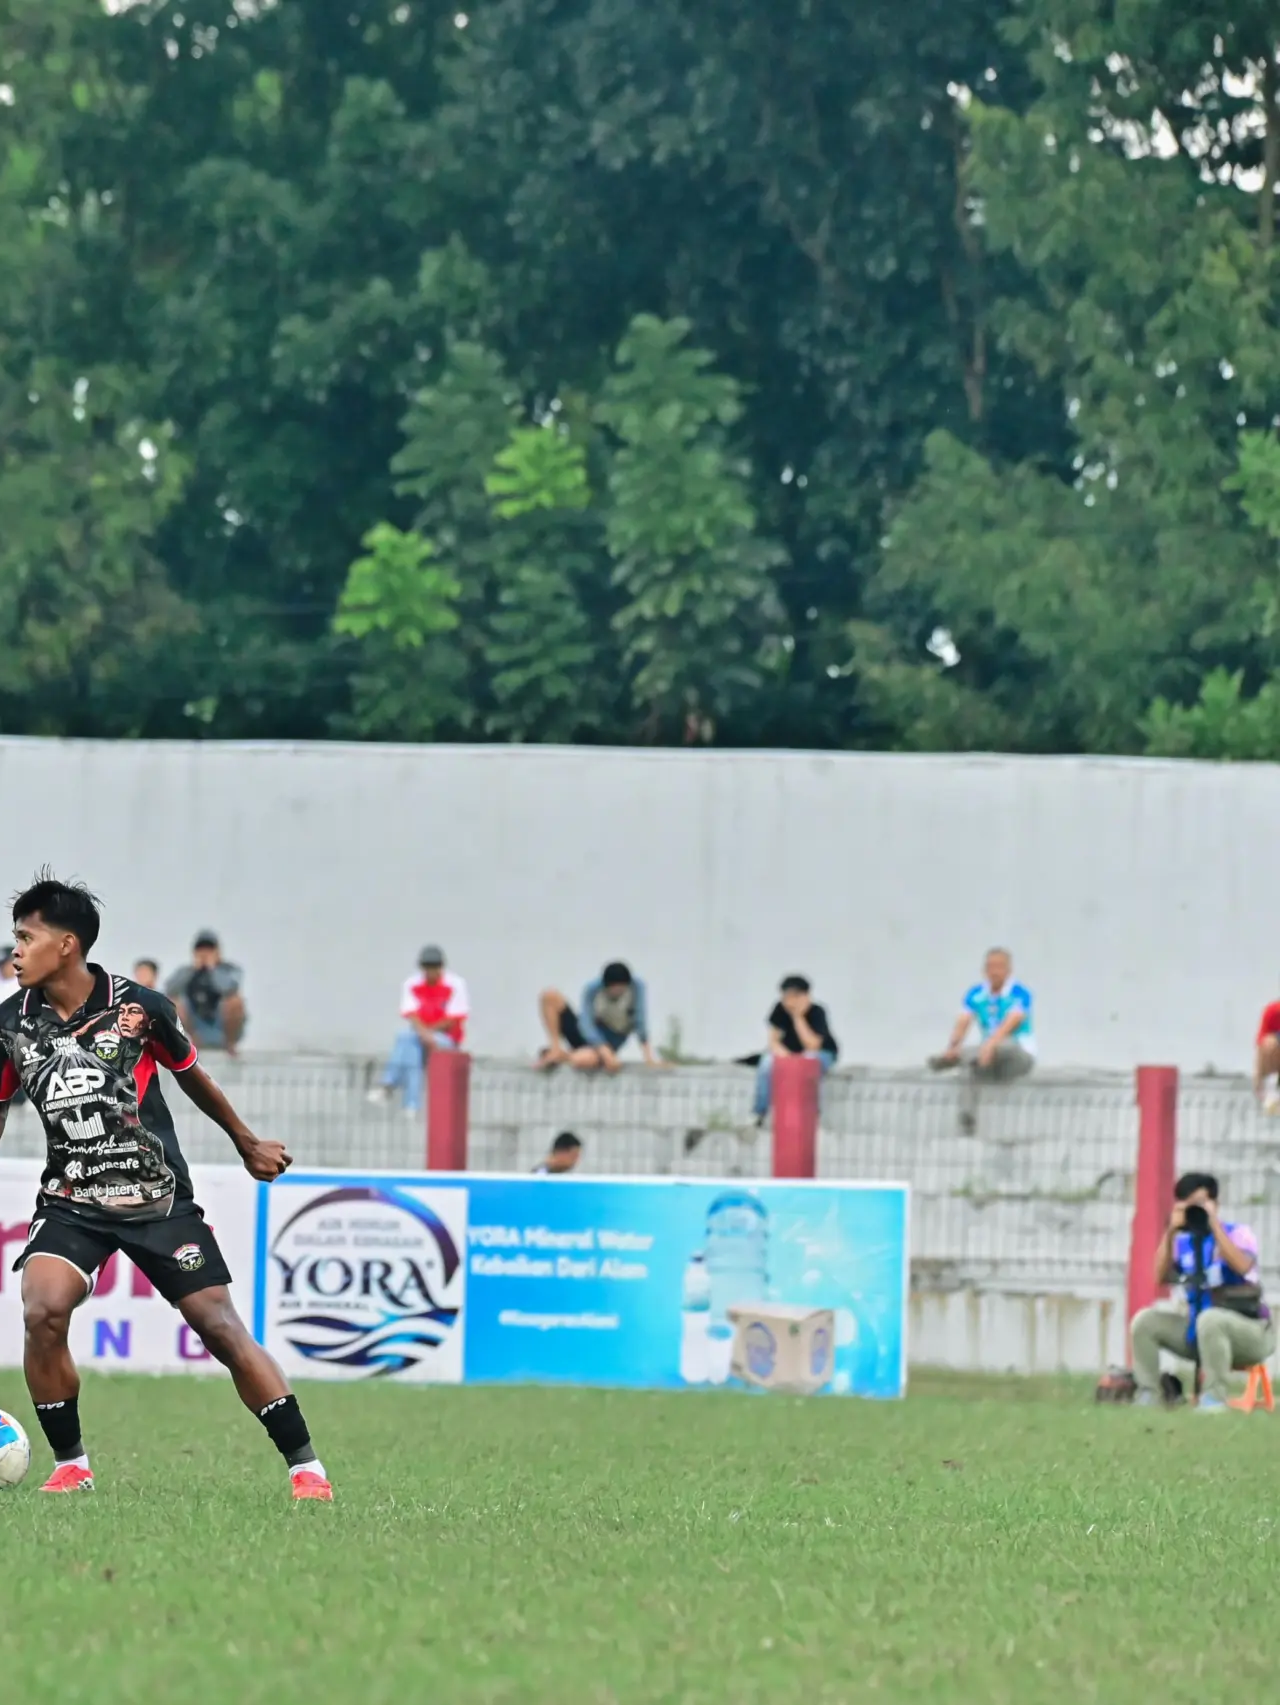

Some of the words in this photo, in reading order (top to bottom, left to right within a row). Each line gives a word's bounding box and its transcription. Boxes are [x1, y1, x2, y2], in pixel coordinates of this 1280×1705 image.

[47, 1067, 106, 1102] ABP
[73, 1183, 102, 1198] Bank
[102, 1183, 141, 1198] Jateng
[270, 1256, 438, 1309] YORA
